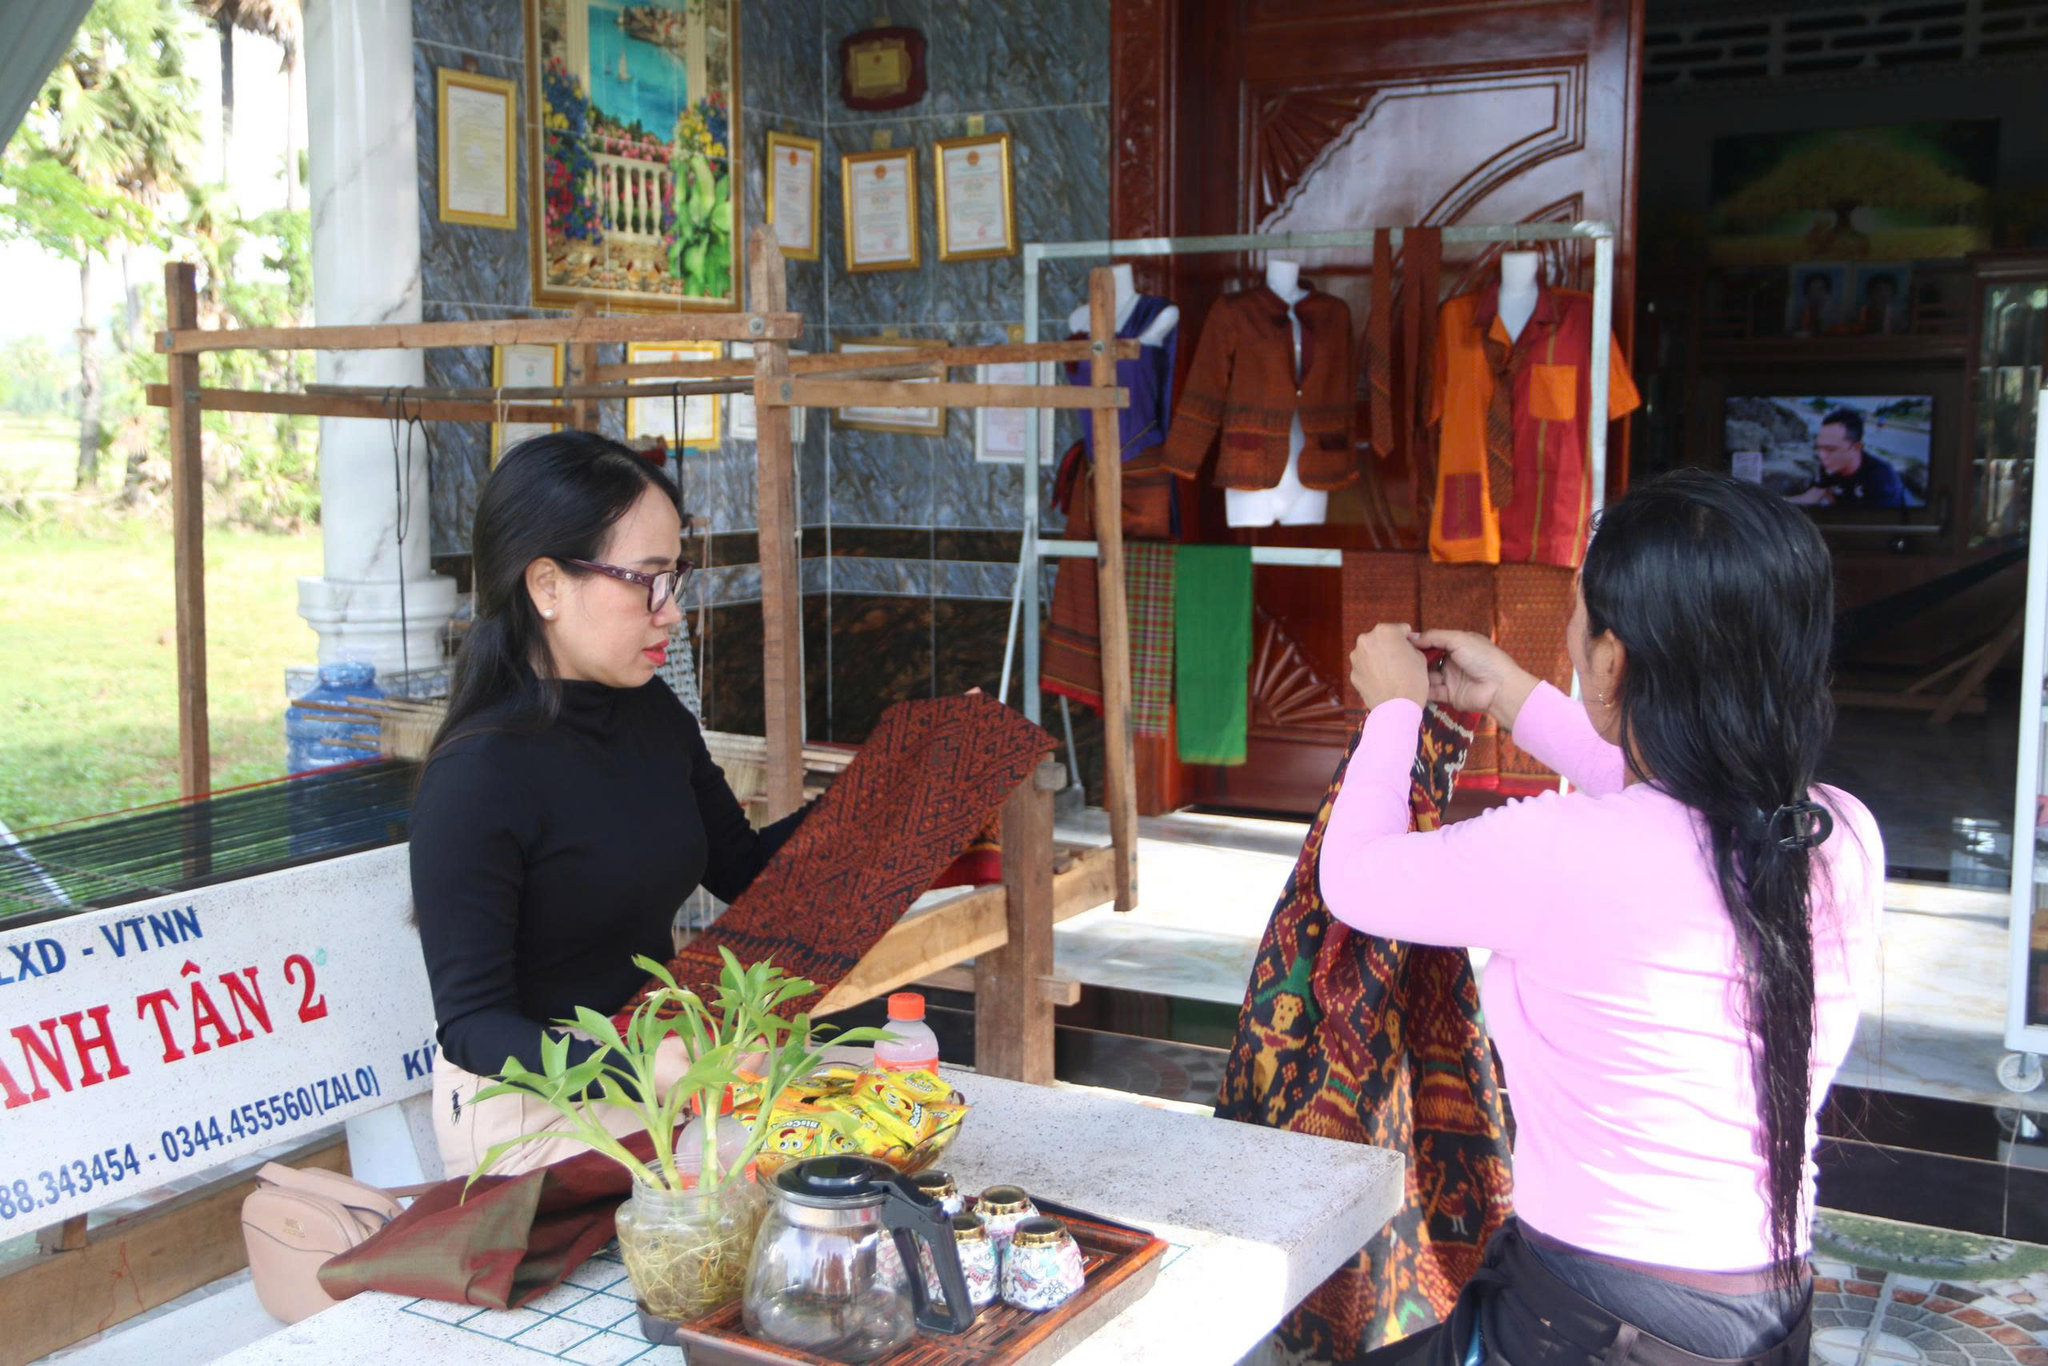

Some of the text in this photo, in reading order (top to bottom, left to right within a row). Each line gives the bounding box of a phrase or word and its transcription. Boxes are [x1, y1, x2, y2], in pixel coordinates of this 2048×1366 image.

[99, 904, 203, 957] VTNN
[137, 959, 273, 1063] TÂN
[283, 954, 328, 1024] 2
